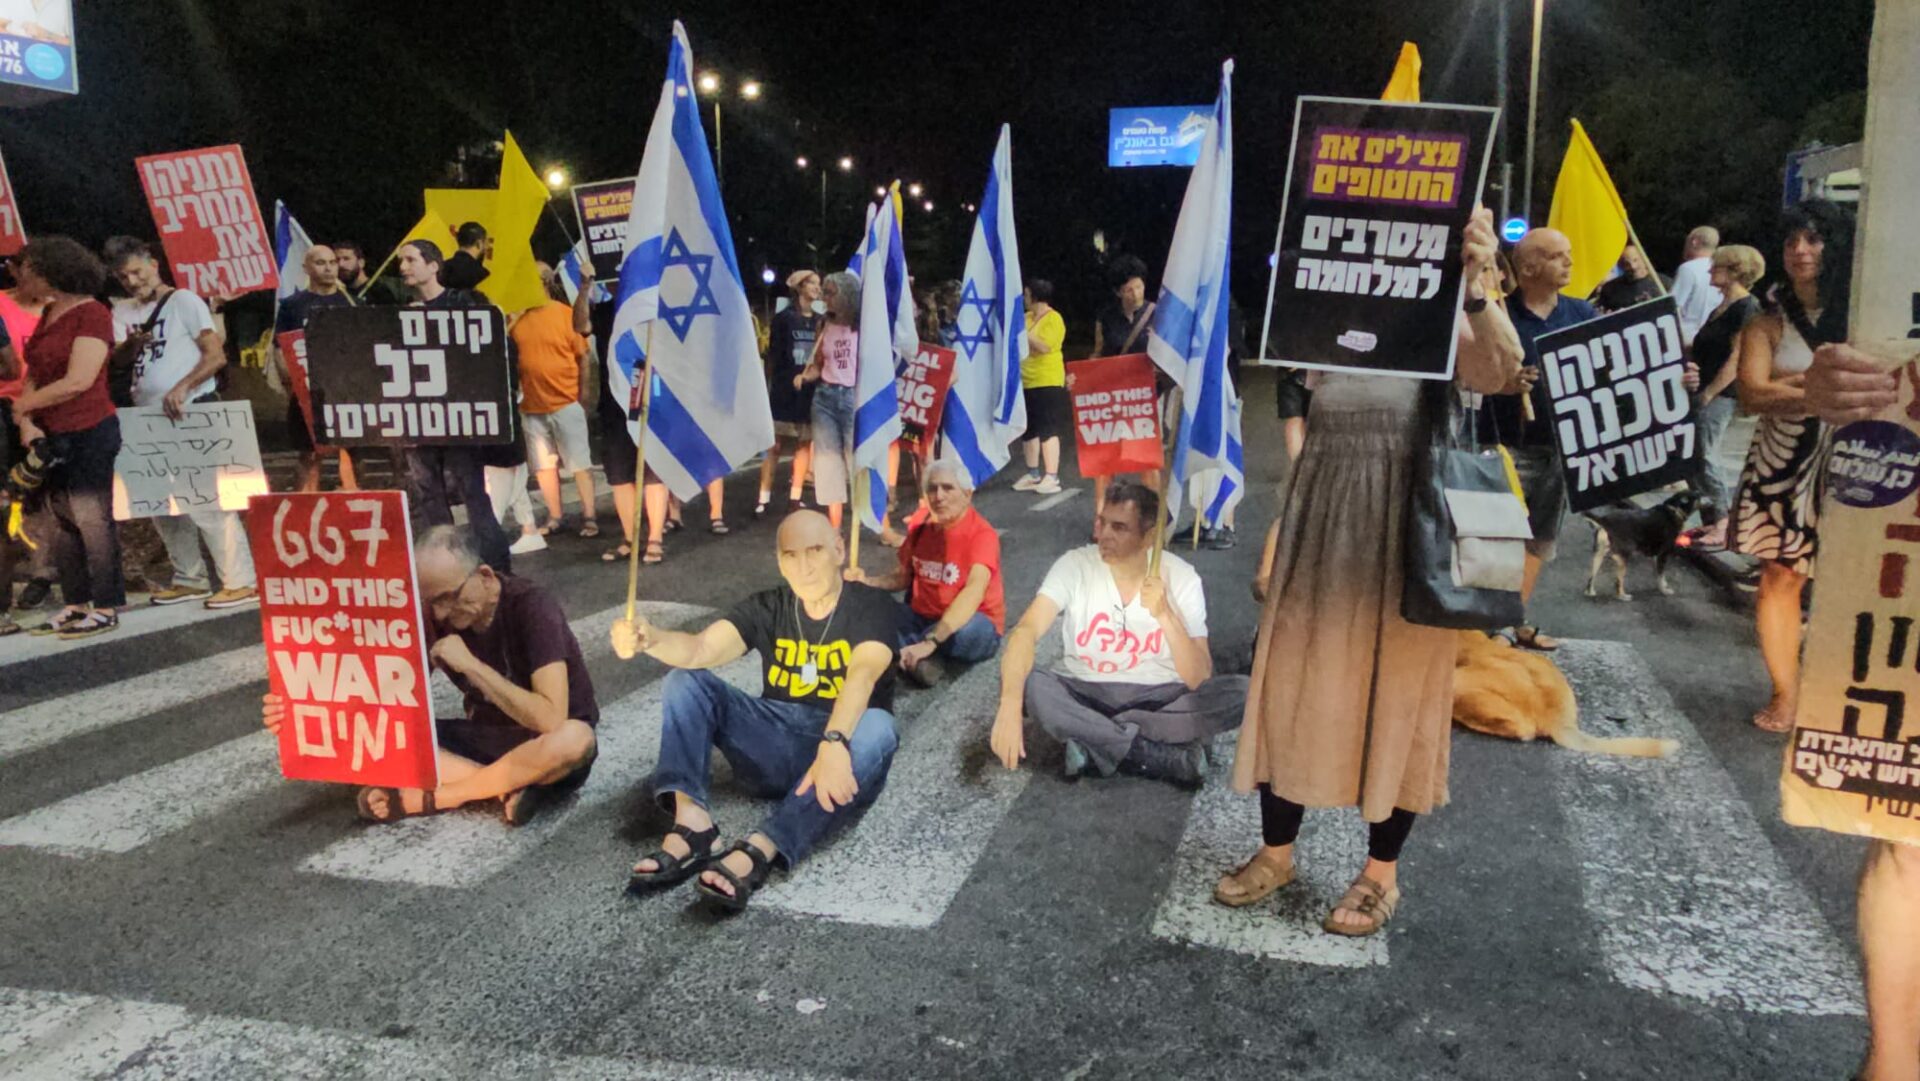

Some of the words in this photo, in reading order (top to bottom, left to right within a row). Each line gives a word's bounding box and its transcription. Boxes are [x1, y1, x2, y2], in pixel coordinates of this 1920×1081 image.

[1318, 134, 1360, 162] את
[1364, 134, 1461, 168] מצילים
[145, 152, 243, 197] נתניהו
[1312, 164, 1455, 202] החטופים
[154, 188, 251, 234] מחריב
[212, 221, 263, 257] את
[1301, 215, 1449, 261] מסרבים
[176, 254, 271, 295] ישראל
[1295, 257, 1442, 299] למלחמה
[399, 310, 493, 354] קודם
[374, 344, 448, 397] כל
[1542, 314, 1683, 400] נתניהו
[323, 401, 499, 438] החטופים!
[1075, 391, 1111, 408] END
[1112, 387, 1153, 403] THIS
[1554, 363, 1690, 455] סכנה
[1079, 417, 1156, 446] WAR
[1567, 422, 1695, 492] לישראל
[272, 497, 389, 568] 667
[264, 577, 329, 605] END
[332, 578, 408, 608] THIS
[273, 650, 420, 707] WAR
[293, 704, 407, 772] ימים
